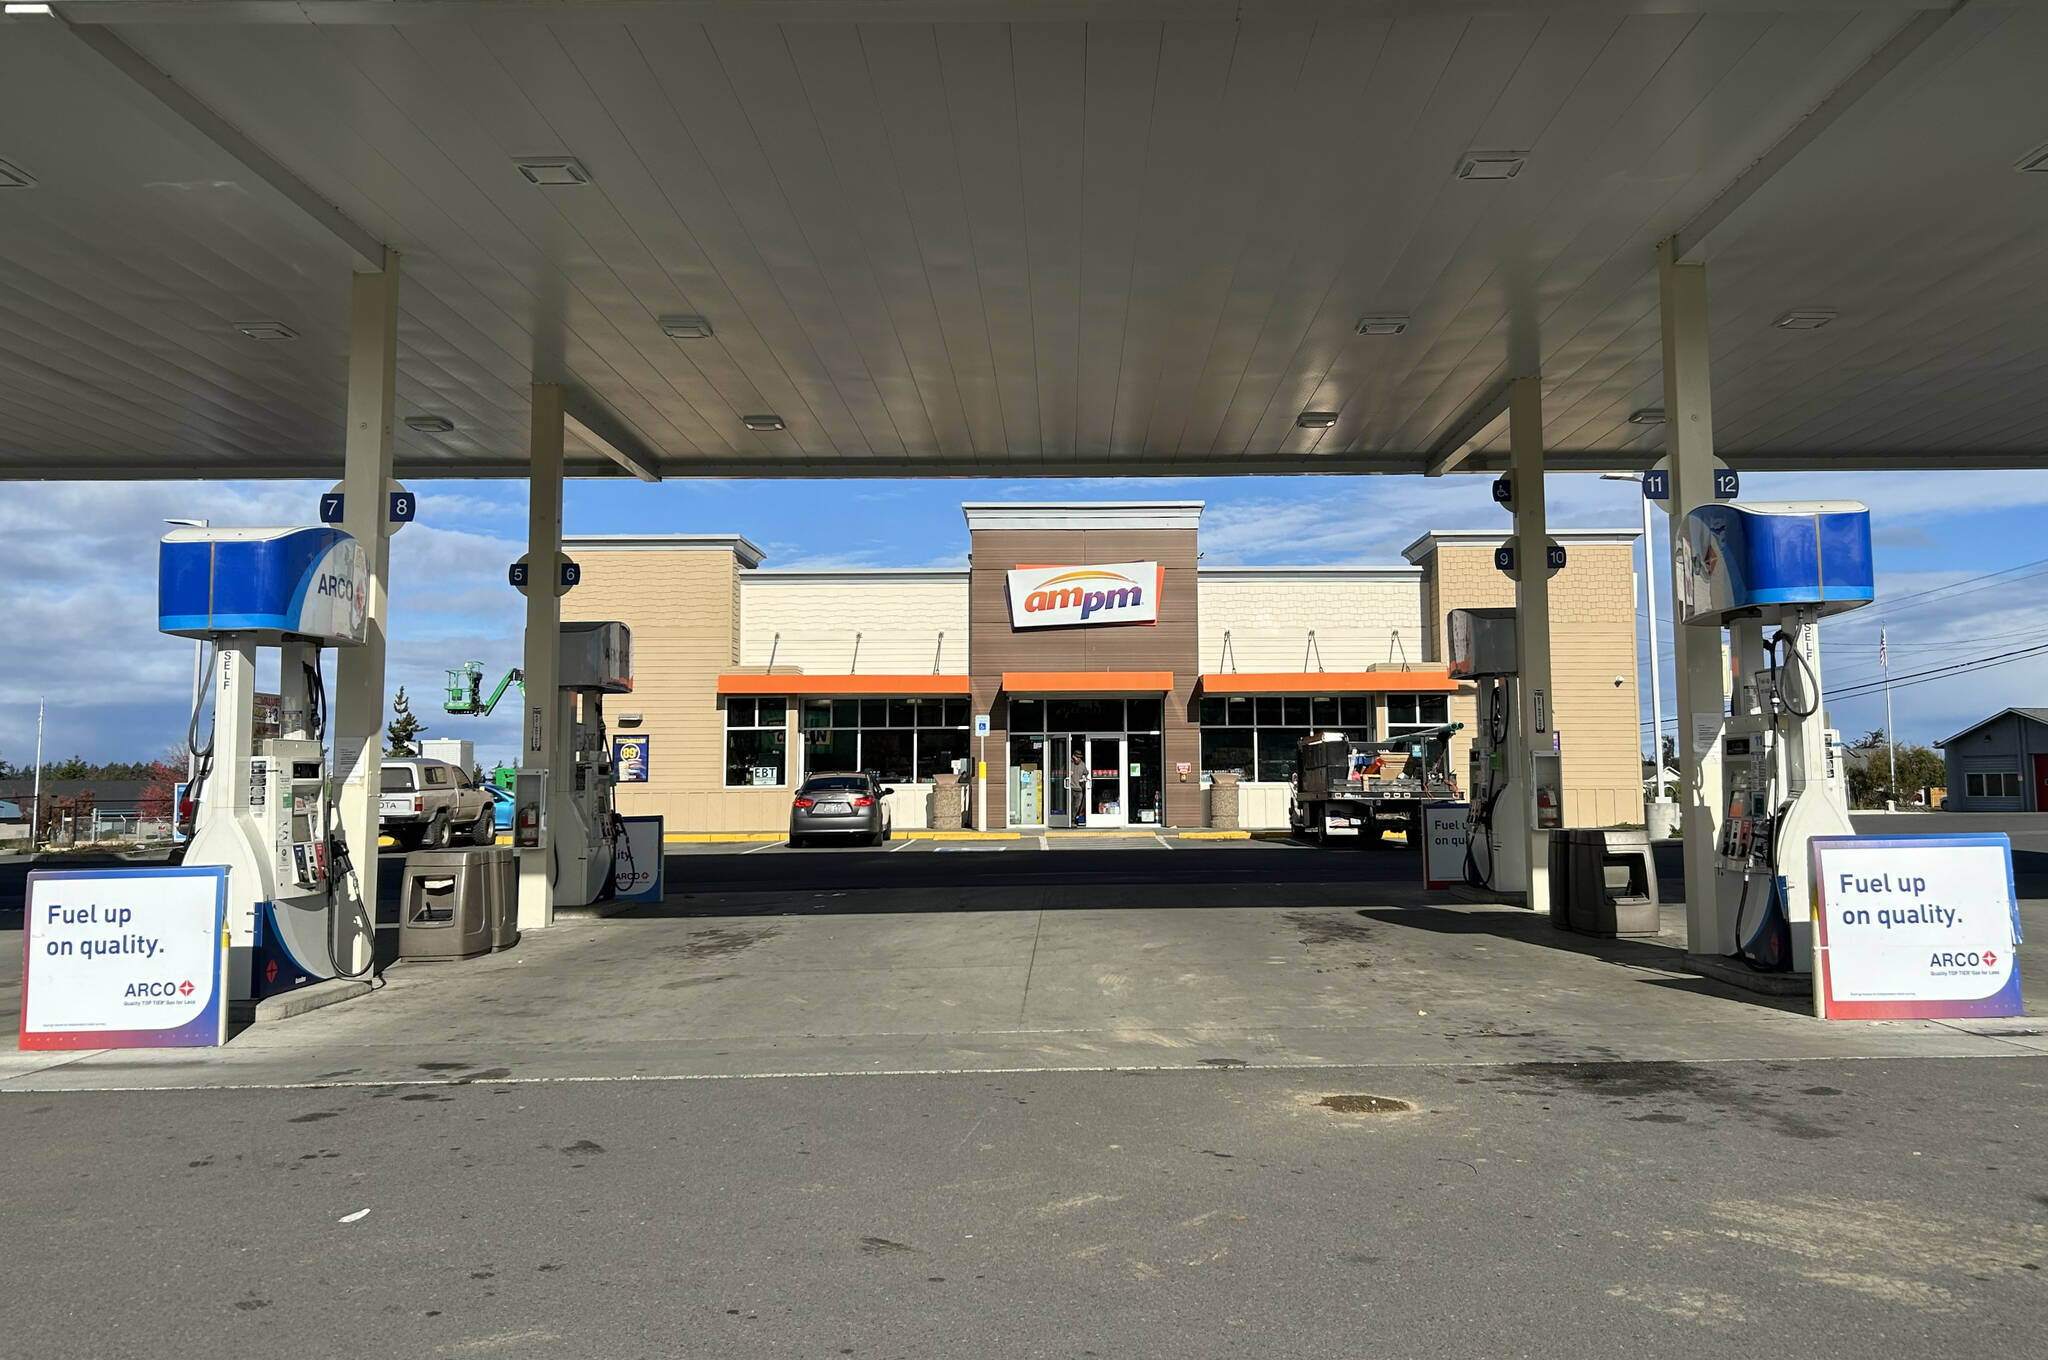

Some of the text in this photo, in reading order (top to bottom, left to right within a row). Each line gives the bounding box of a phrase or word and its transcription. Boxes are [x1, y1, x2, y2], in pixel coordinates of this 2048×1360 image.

[1647, 476, 1662, 492] 11
[1717, 476, 1736, 492] 12
[327, 499, 338, 516] 7
[396, 498, 407, 515] 8
[1499, 552, 1509, 566] 9
[1550, 551, 1564, 564] 10
[513, 568, 523, 581] 5
[566, 567, 575, 581] 6
[317, 573, 354, 602] ARCO
[1024, 586, 1142, 620] ampm
[1803, 622, 1813, 661] SELF
[223, 651, 232, 690] SELF
[754, 767, 776, 778] EBT
[1434, 820, 1459, 830] Fuel
[1435, 837, 1449, 845] on
[1840, 873, 1926, 896] Fuel up
[48, 904, 132, 927] Fuel up
[1842, 903, 1963, 929] on quality.
[46, 934, 164, 959] on quality.
[1930, 952, 1980, 967] ARCO
[124, 982, 176, 997] ARCO
